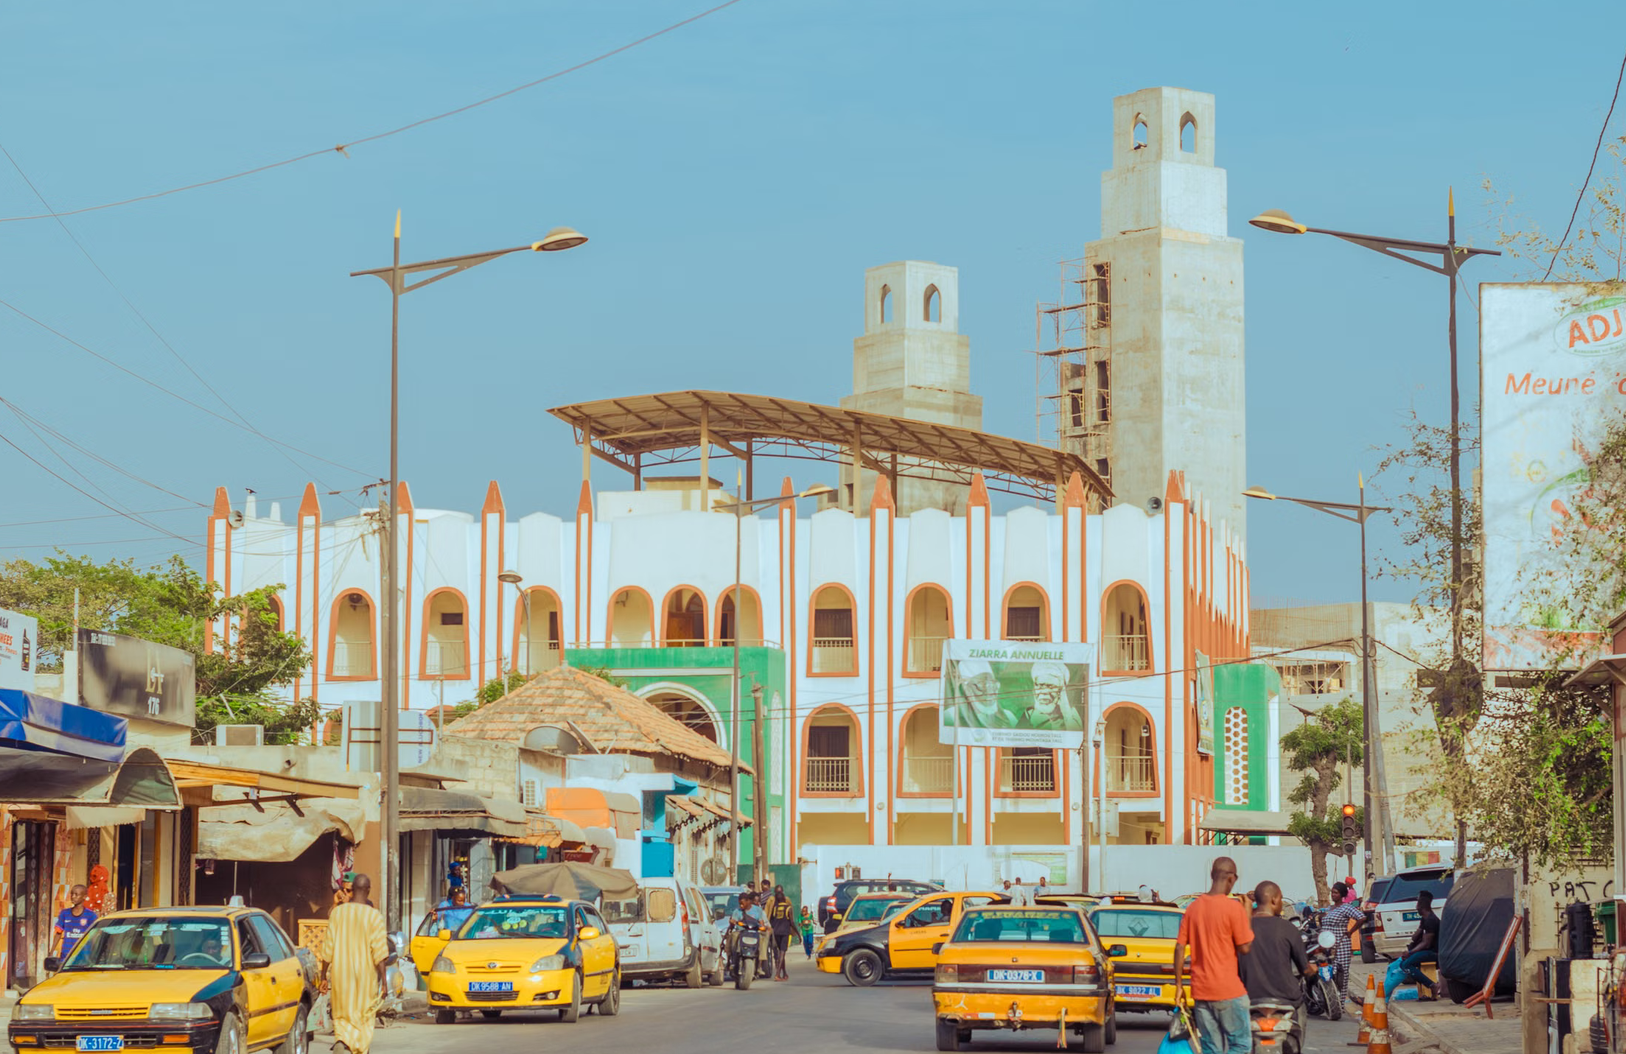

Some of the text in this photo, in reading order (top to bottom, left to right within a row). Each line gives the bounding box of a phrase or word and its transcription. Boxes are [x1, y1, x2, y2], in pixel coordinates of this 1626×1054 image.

[1569, 309, 1626, 348] ADJ
[969, 649, 1064, 660] ZIARRA ANNUELLE
